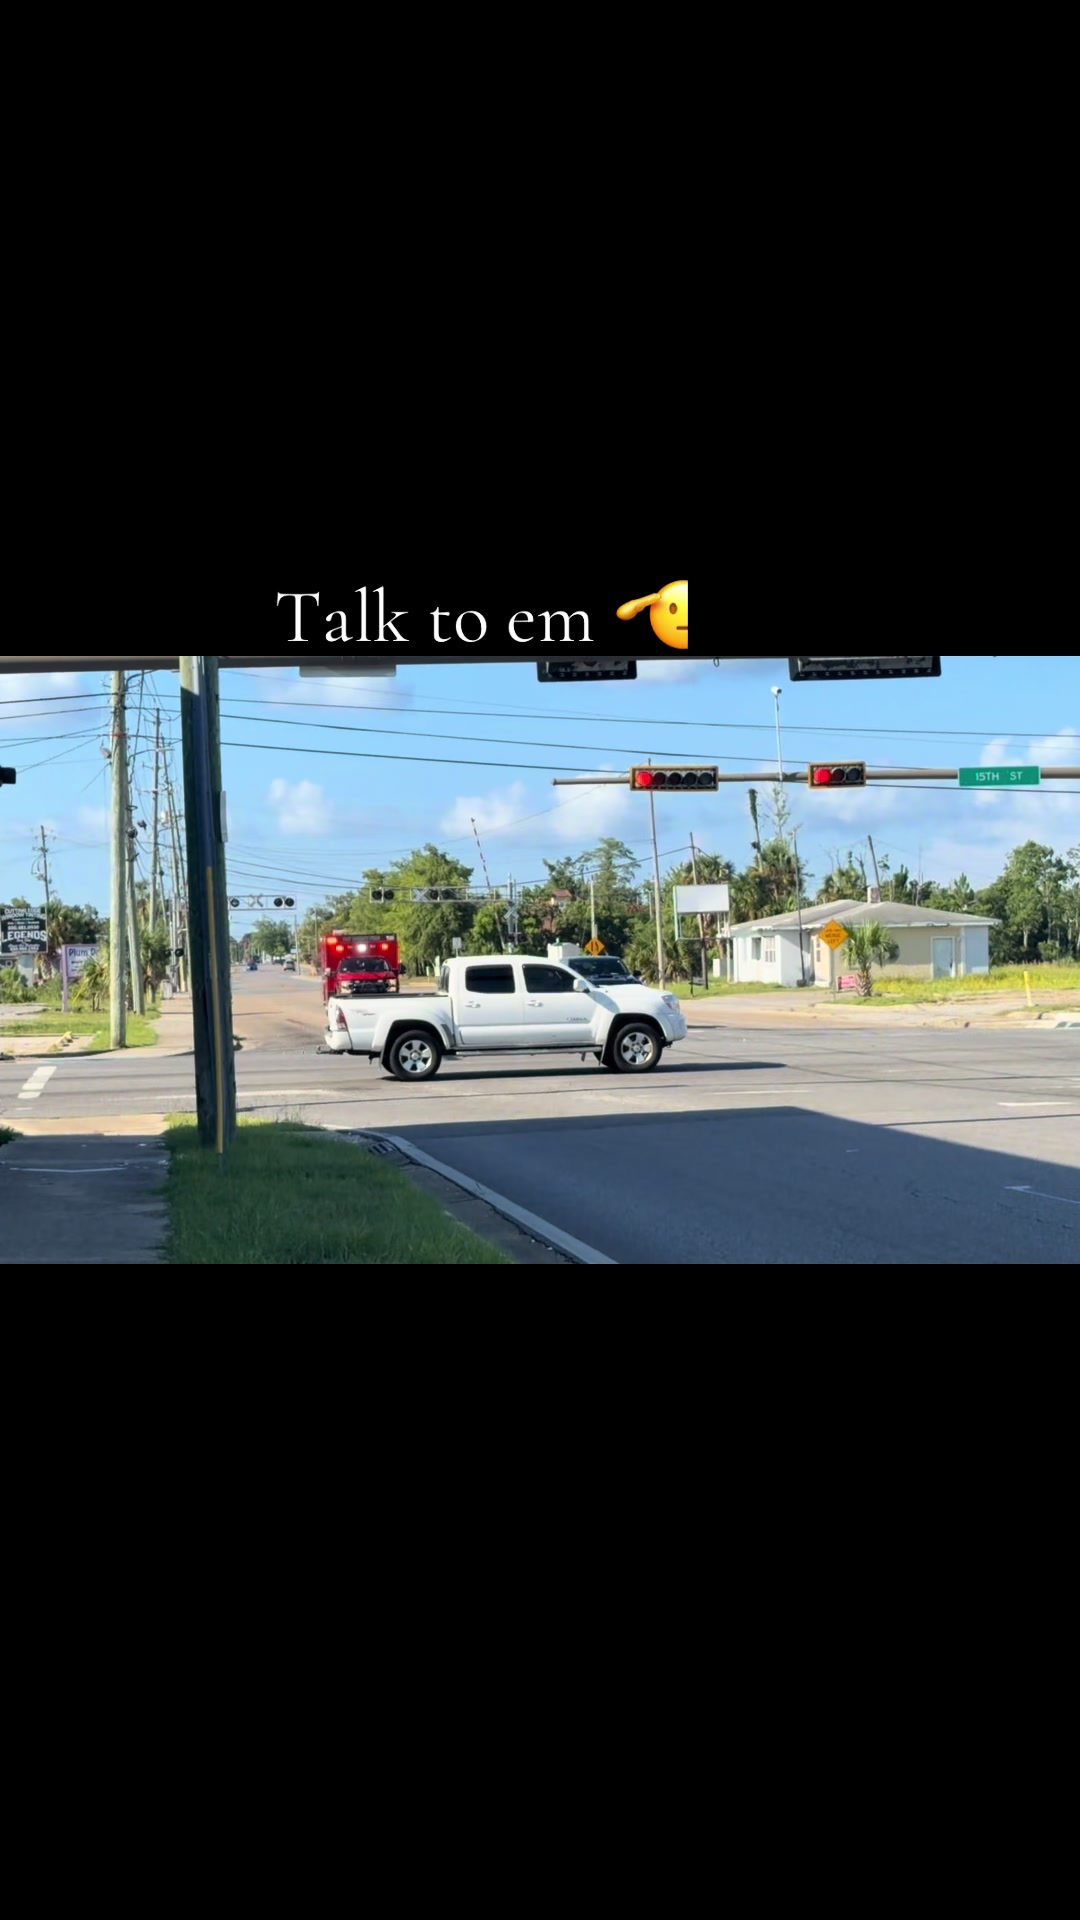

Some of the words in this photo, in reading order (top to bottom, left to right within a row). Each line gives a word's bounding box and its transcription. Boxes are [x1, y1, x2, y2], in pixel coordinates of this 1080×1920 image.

[975, 771, 1000, 781] 15TH
[1009, 771, 1024, 781] ST
[1, 930, 47, 942] LEGENDS
[69, 948, 88, 957] Plum
